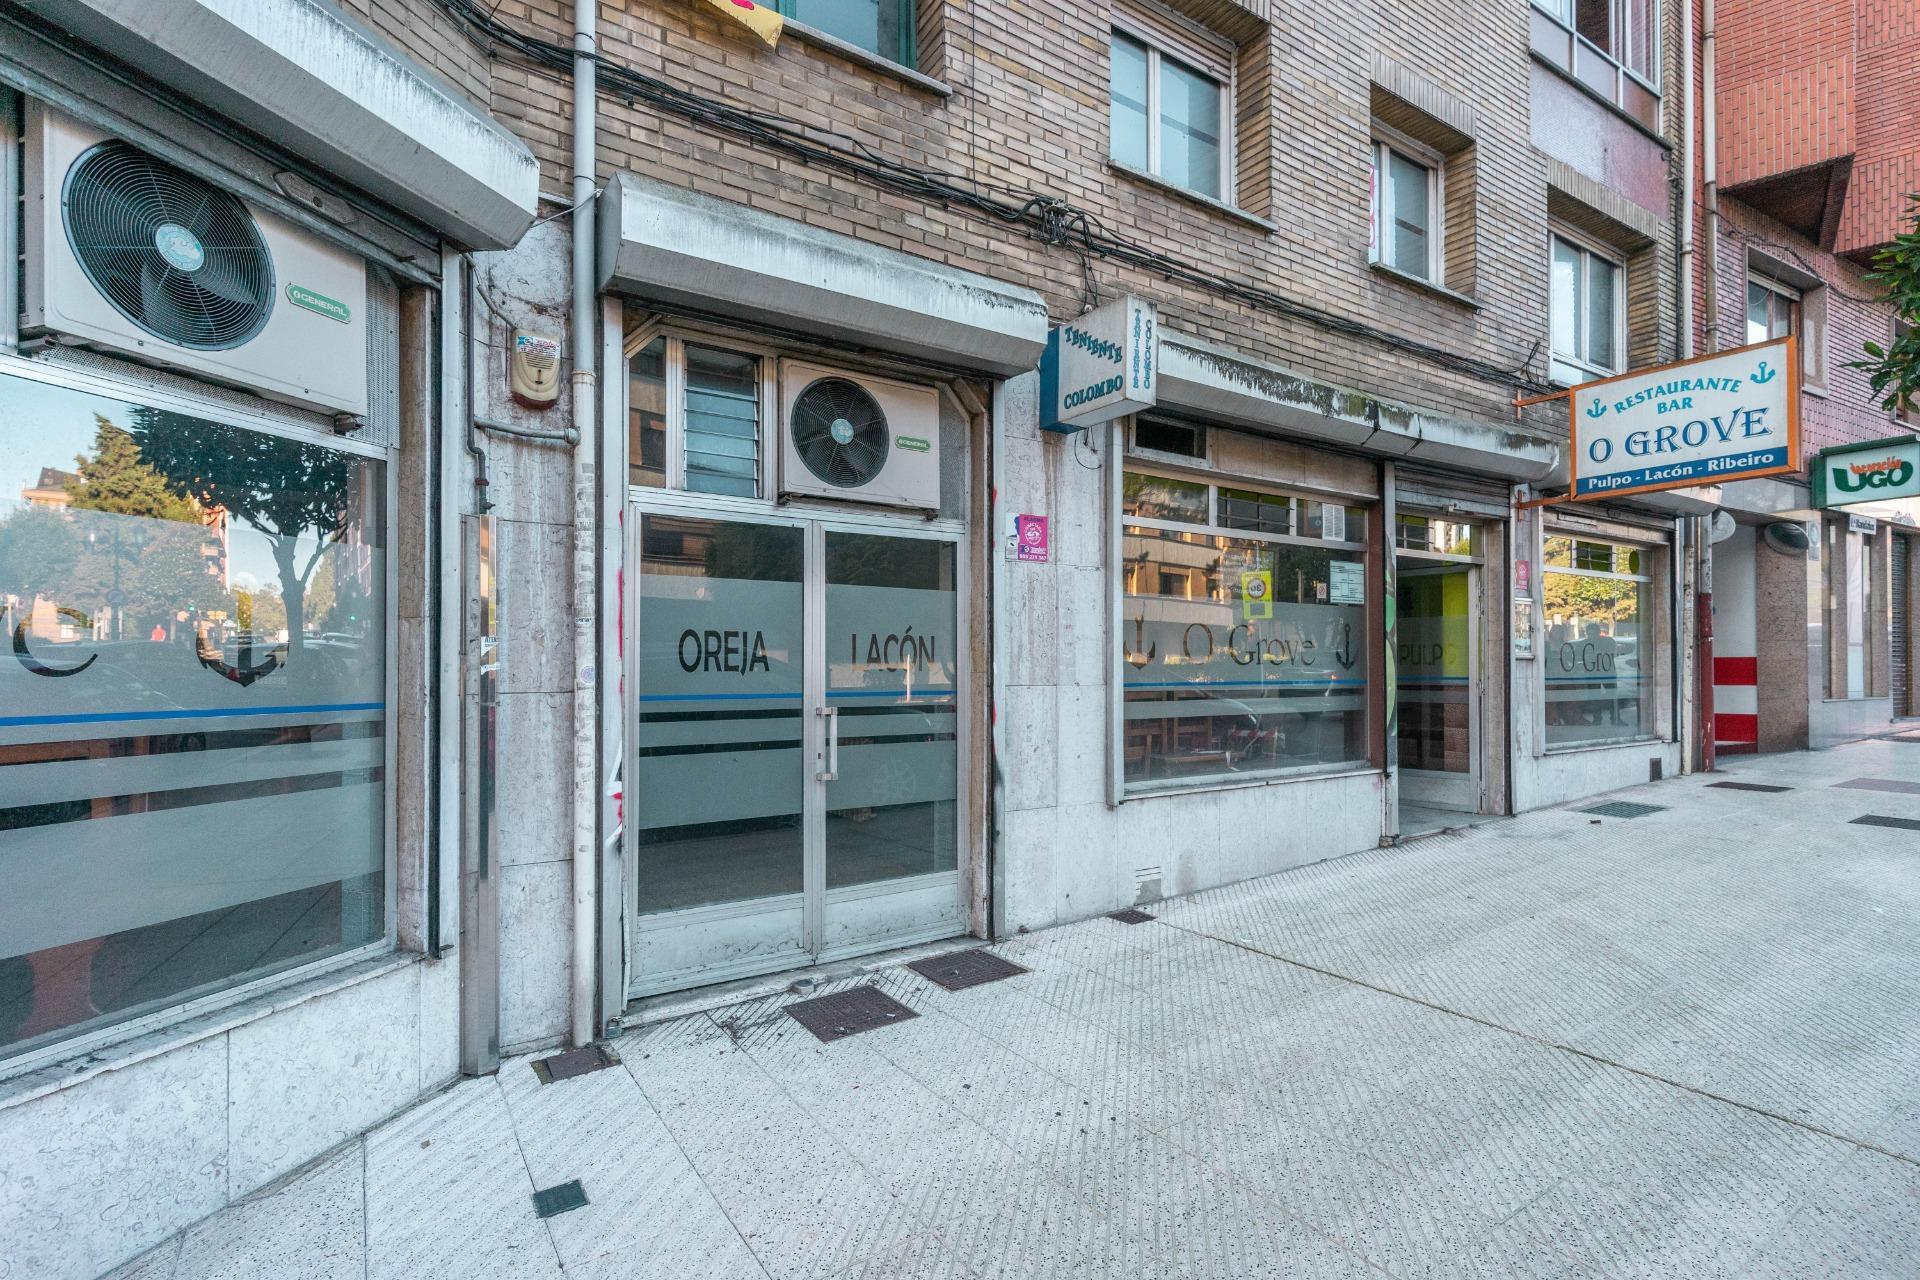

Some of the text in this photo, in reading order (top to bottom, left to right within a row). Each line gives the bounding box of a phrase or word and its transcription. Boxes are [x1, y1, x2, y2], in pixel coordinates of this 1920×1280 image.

[1065, 326, 1122, 364] TENIENTE
[1133, 308, 1142, 389] TENIENTE
[1144, 319, 1152, 389] COLOMBO
[1064, 375, 1123, 409] COLOMBO
[1613, 377, 1742, 414] RESTAURANTE
[1657, 396, 1693, 414] BAR
[1589, 406, 1773, 463] O GROVE
[1588, 475, 1632, 490] Pulpo
[1645, 464, 1693, 482] Lacón
[1707, 454, 1774, 471] Ribeiro
[1832, 461, 1914, 492] UGO
[678, 628, 770, 676] OREJA
[852, 625, 936, 673] LACÓN
[1183, 623, 1316, 666] O Grove
